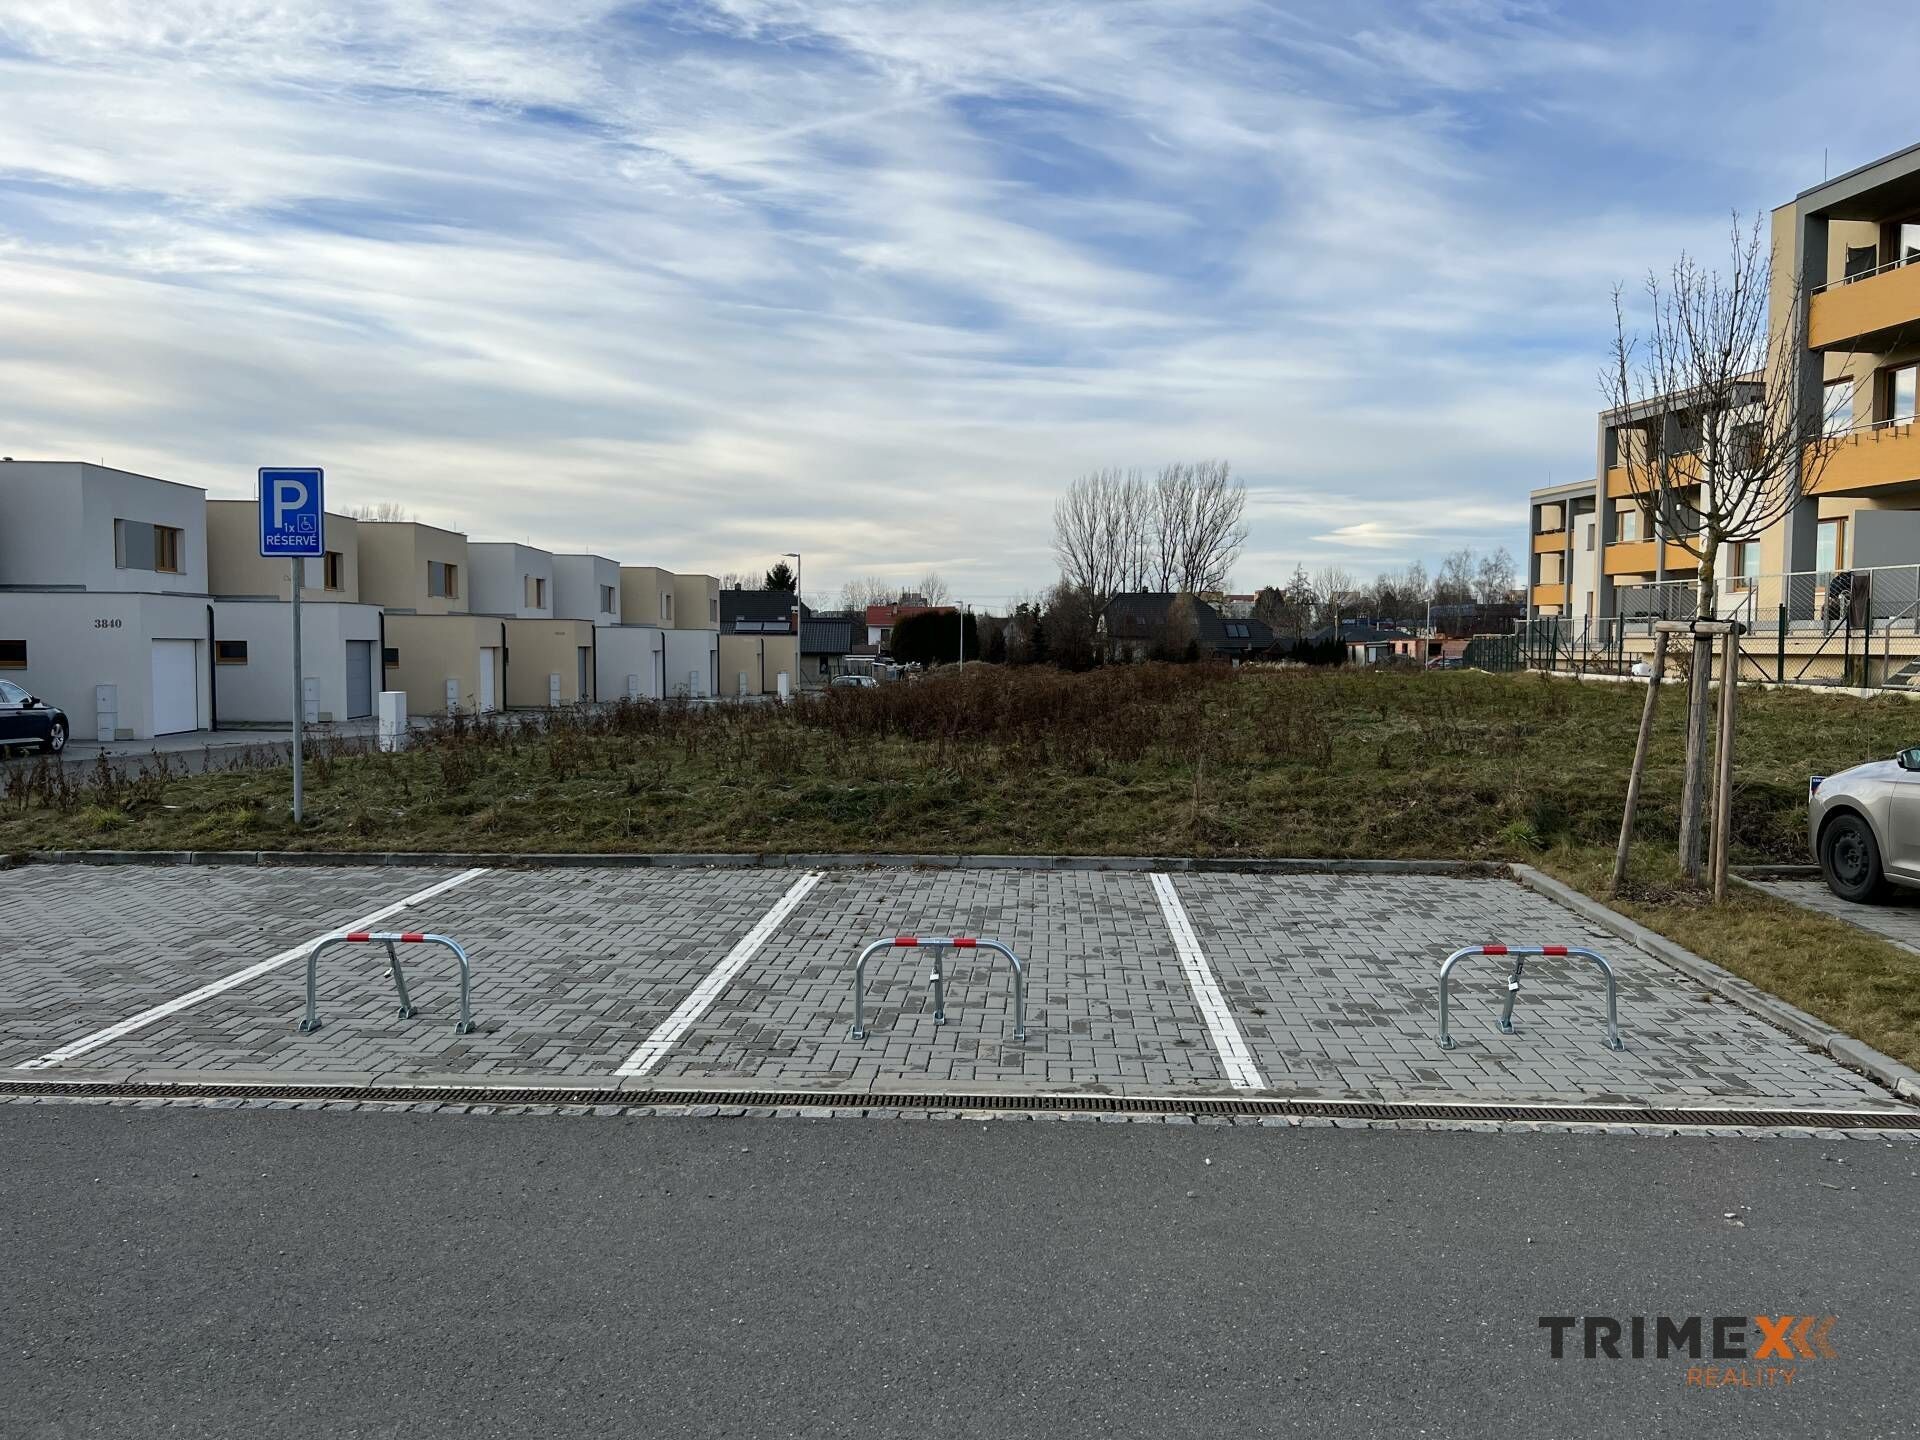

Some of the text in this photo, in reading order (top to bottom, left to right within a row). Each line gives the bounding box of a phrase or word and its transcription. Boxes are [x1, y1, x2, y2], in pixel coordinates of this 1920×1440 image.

[273, 479, 308, 529] P
[284, 522, 295, 533] 1x
[266, 533, 317, 546] RÉSERVÉ
[94, 618, 122, 629] 3840
